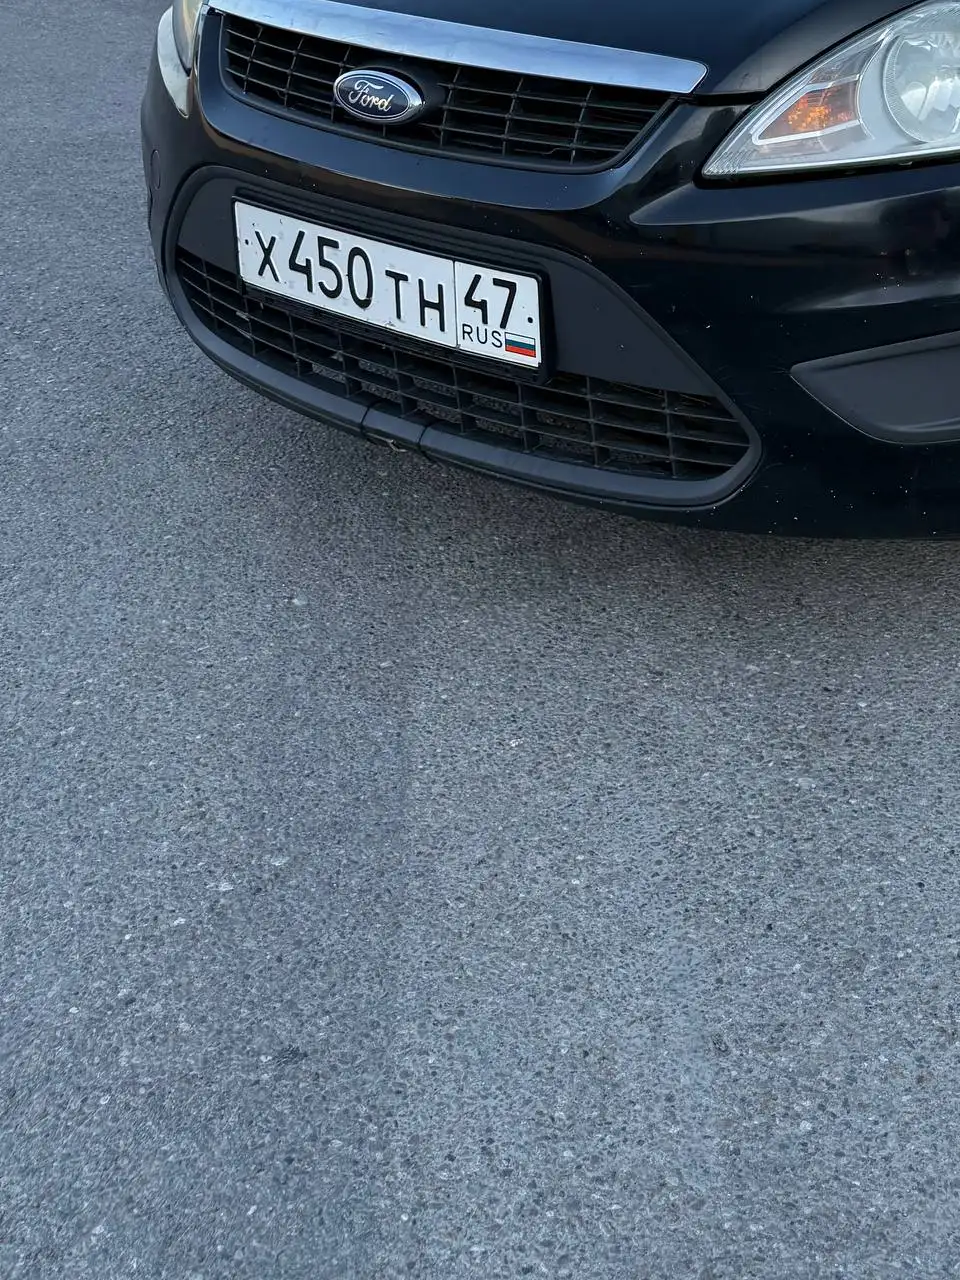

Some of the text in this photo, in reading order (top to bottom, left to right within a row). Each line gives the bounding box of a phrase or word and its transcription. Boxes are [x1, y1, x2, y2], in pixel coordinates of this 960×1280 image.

[348, 80, 394, 112] Ford
[463, 273, 518, 330] 47
[461, 323, 504, 349] RUS
